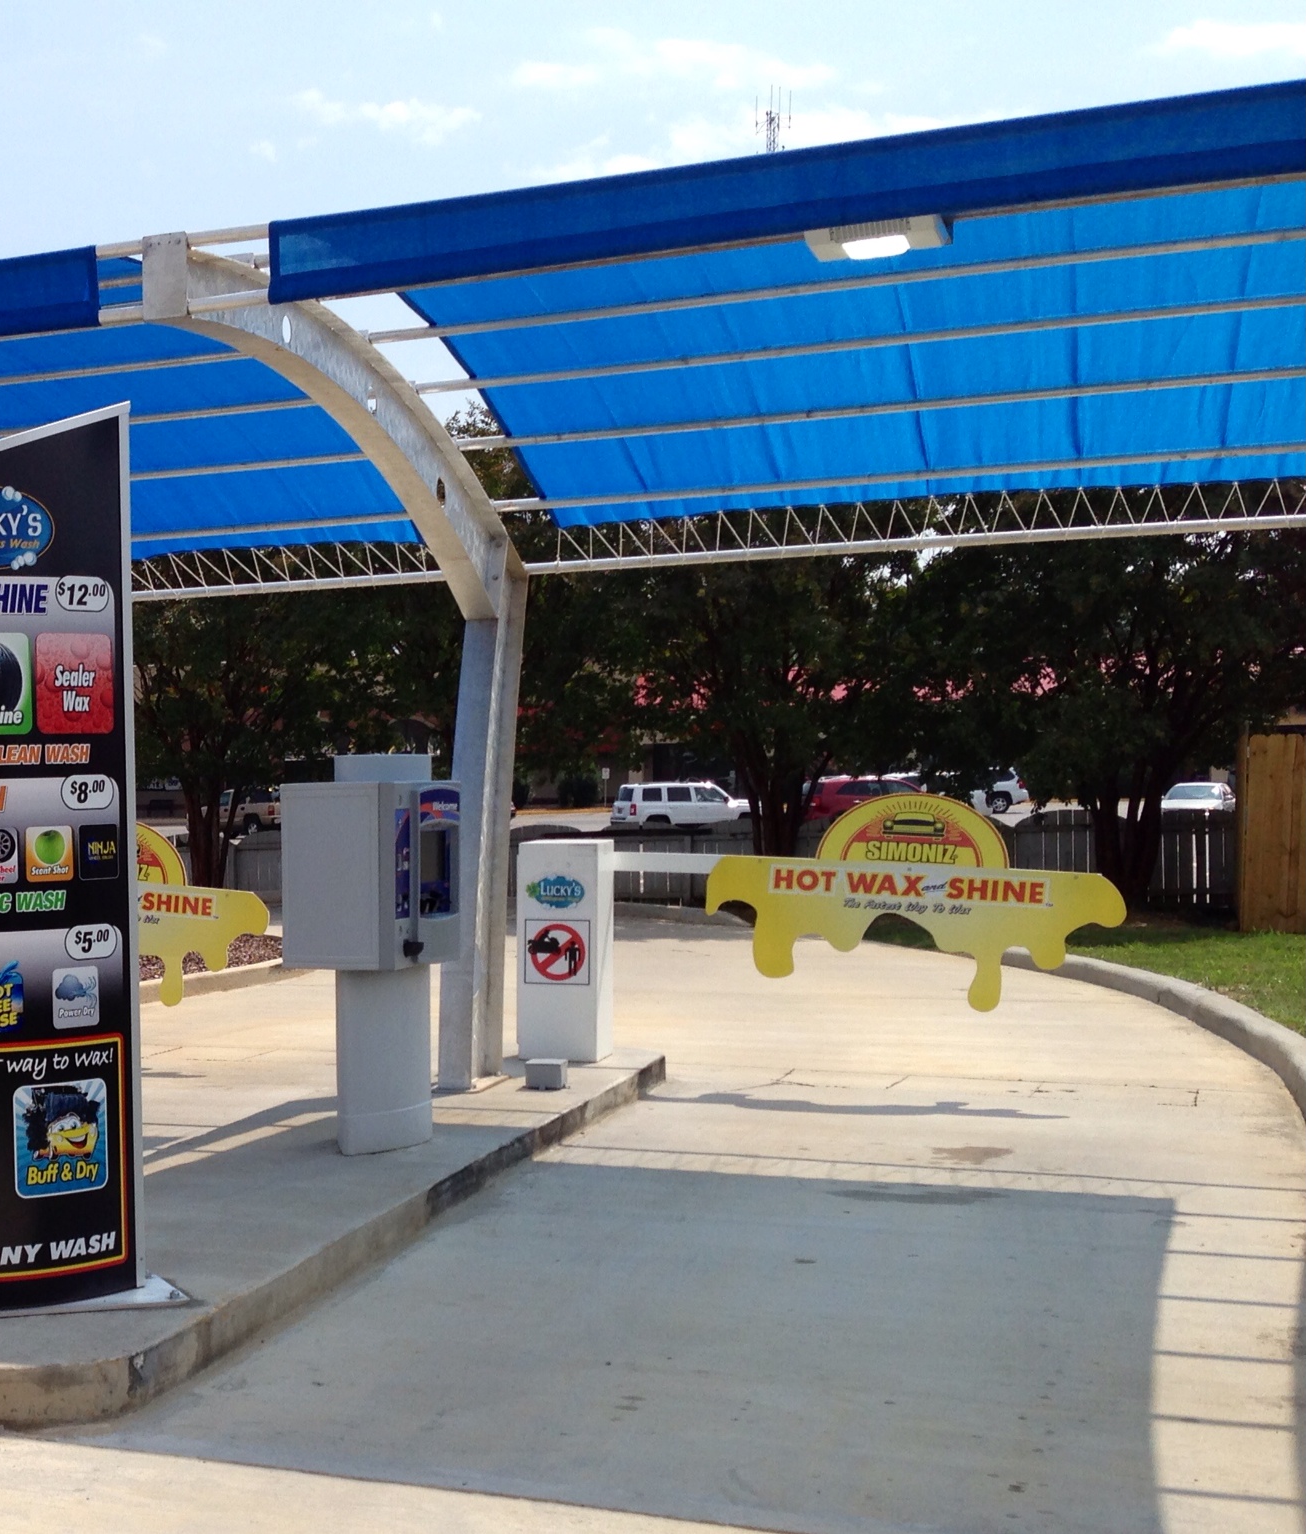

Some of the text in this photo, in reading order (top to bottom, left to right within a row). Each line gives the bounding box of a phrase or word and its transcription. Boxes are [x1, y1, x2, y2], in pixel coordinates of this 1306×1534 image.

[10, 538, 40, 549] Wash
[58, 582, 106, 606] $12.00
[54, 664, 95, 687] Sealer
[62, 690, 90, 713] Wax
[45, 744, 91, 764] WASH
[70, 779, 105, 804] $8.00
[88, 841, 116, 855] NINJA
[866, 840, 956, 864] SIMONIZ
[31, 866, 69, 876] Scent Shot
[774, 868, 1044, 904] HOT WAX and SHINE
[16, 890, 66, 912] WASH
[142, 892, 212, 916] SHINE
[844, 898, 972, 915] The Fastest Way To Wax
[75, 929, 109, 954] $5.00
[58, 1008, 95, 1019] Power Dry
[6, 1056, 46, 1080] way
[52, 1053, 70, 1069] to
[27, 1160, 99, 1186] Buff & Dry
[50, 1231, 116, 1259] WASH
